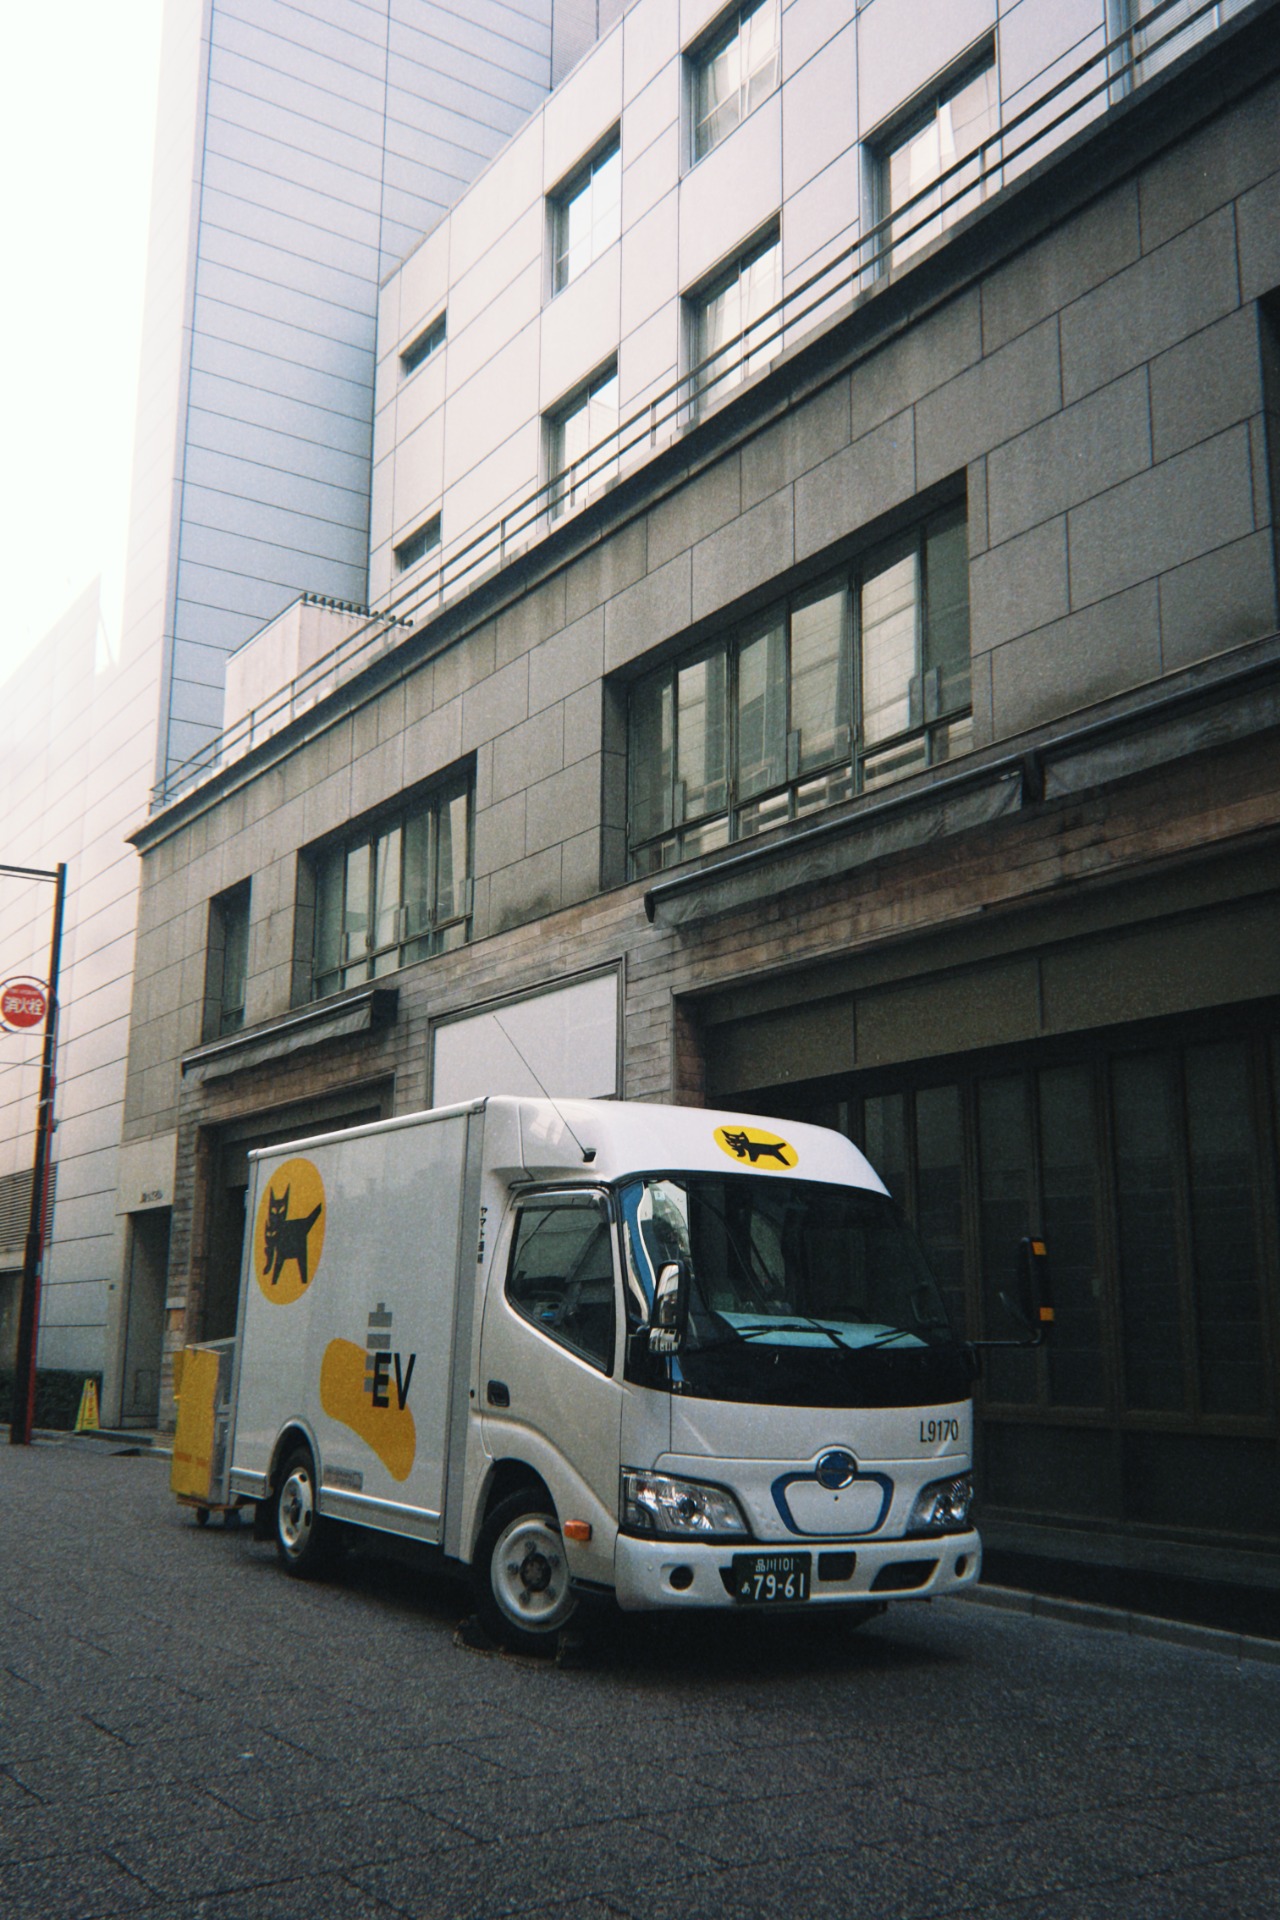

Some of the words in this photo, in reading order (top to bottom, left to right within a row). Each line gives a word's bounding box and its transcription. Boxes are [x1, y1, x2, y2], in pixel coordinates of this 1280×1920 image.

[477, 1206, 489, 1264] ヤマト
[372, 1352, 416, 1411] EV
[920, 1419, 959, 1443] L9170
[753, 1573, 804, 1600] 79-61
